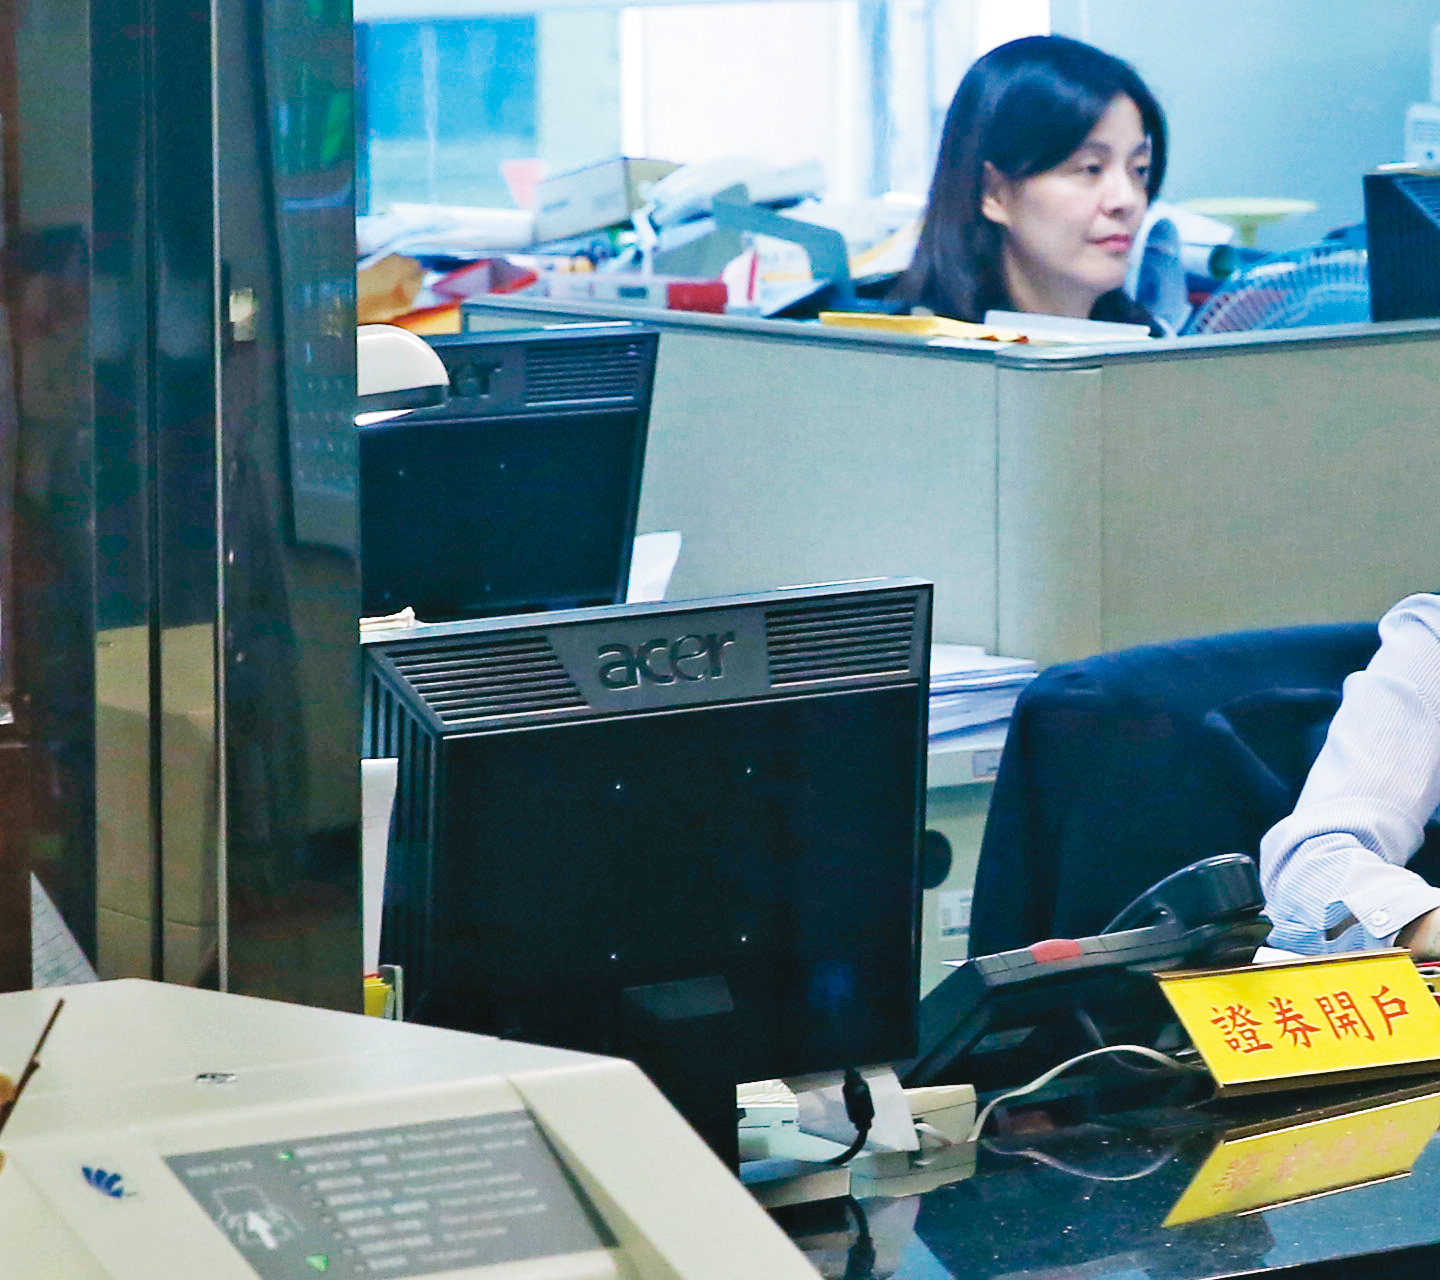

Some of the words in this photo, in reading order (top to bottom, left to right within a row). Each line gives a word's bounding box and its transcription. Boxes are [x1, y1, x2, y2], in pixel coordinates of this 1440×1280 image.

[595, 628, 737, 691] acer
[1210, 983, 1411, 1057] 證券開戶
